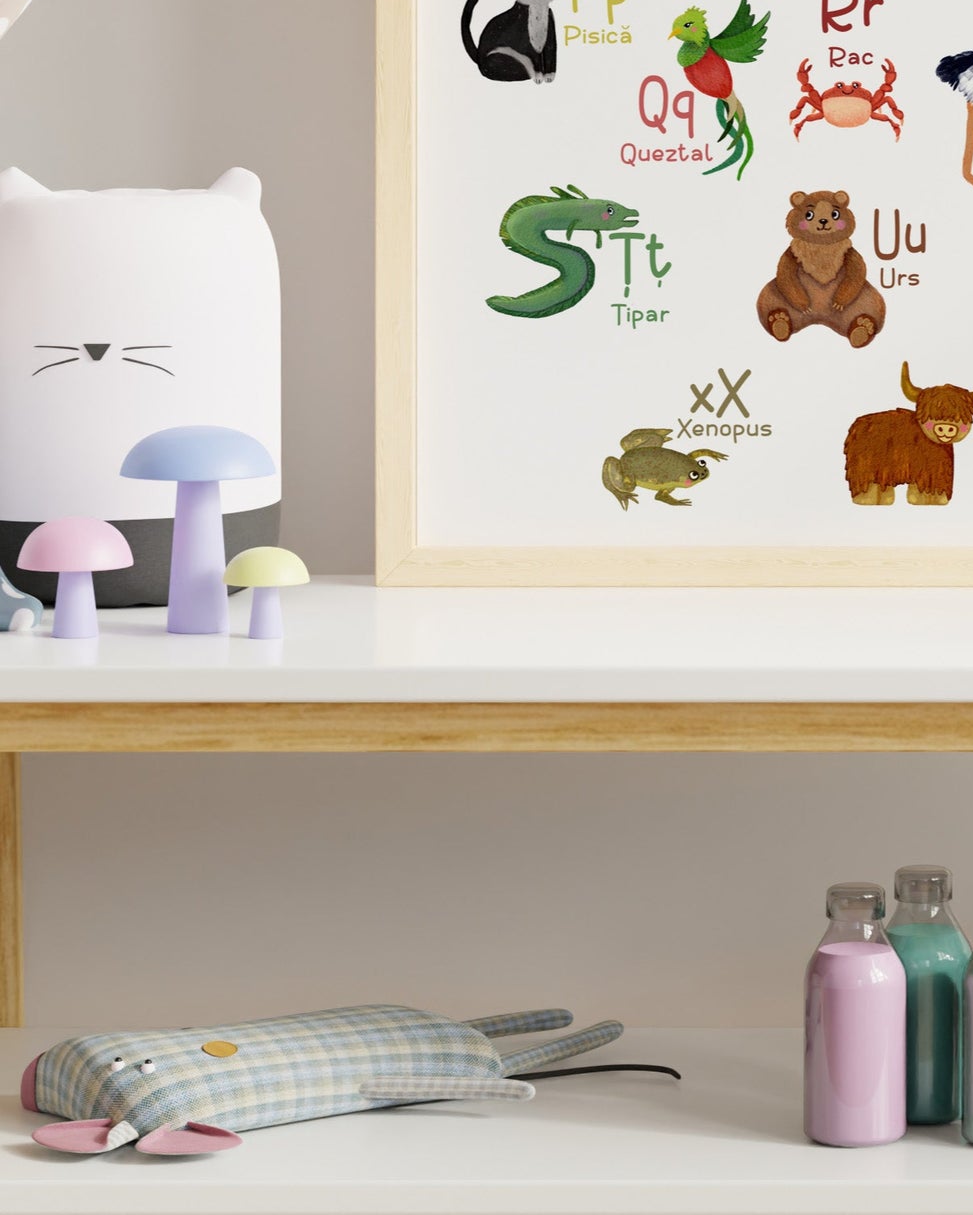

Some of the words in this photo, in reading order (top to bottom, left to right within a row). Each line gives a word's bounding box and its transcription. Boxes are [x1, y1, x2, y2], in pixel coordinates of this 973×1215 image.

[564, 25, 632, 46] Pisică
[828, 46, 873, 68] Rac
[639, 75, 695, 138] Qq
[620, 143, 713, 166] Queztal
[873, 209, 926, 260] Uu
[608, 232, 672, 298] Țț
[880, 268, 920, 288] Urs
[611, 304, 669, 329] Tipar
[690, 367, 751, 419] xX
[676, 418, 773, 443] Xenopus
